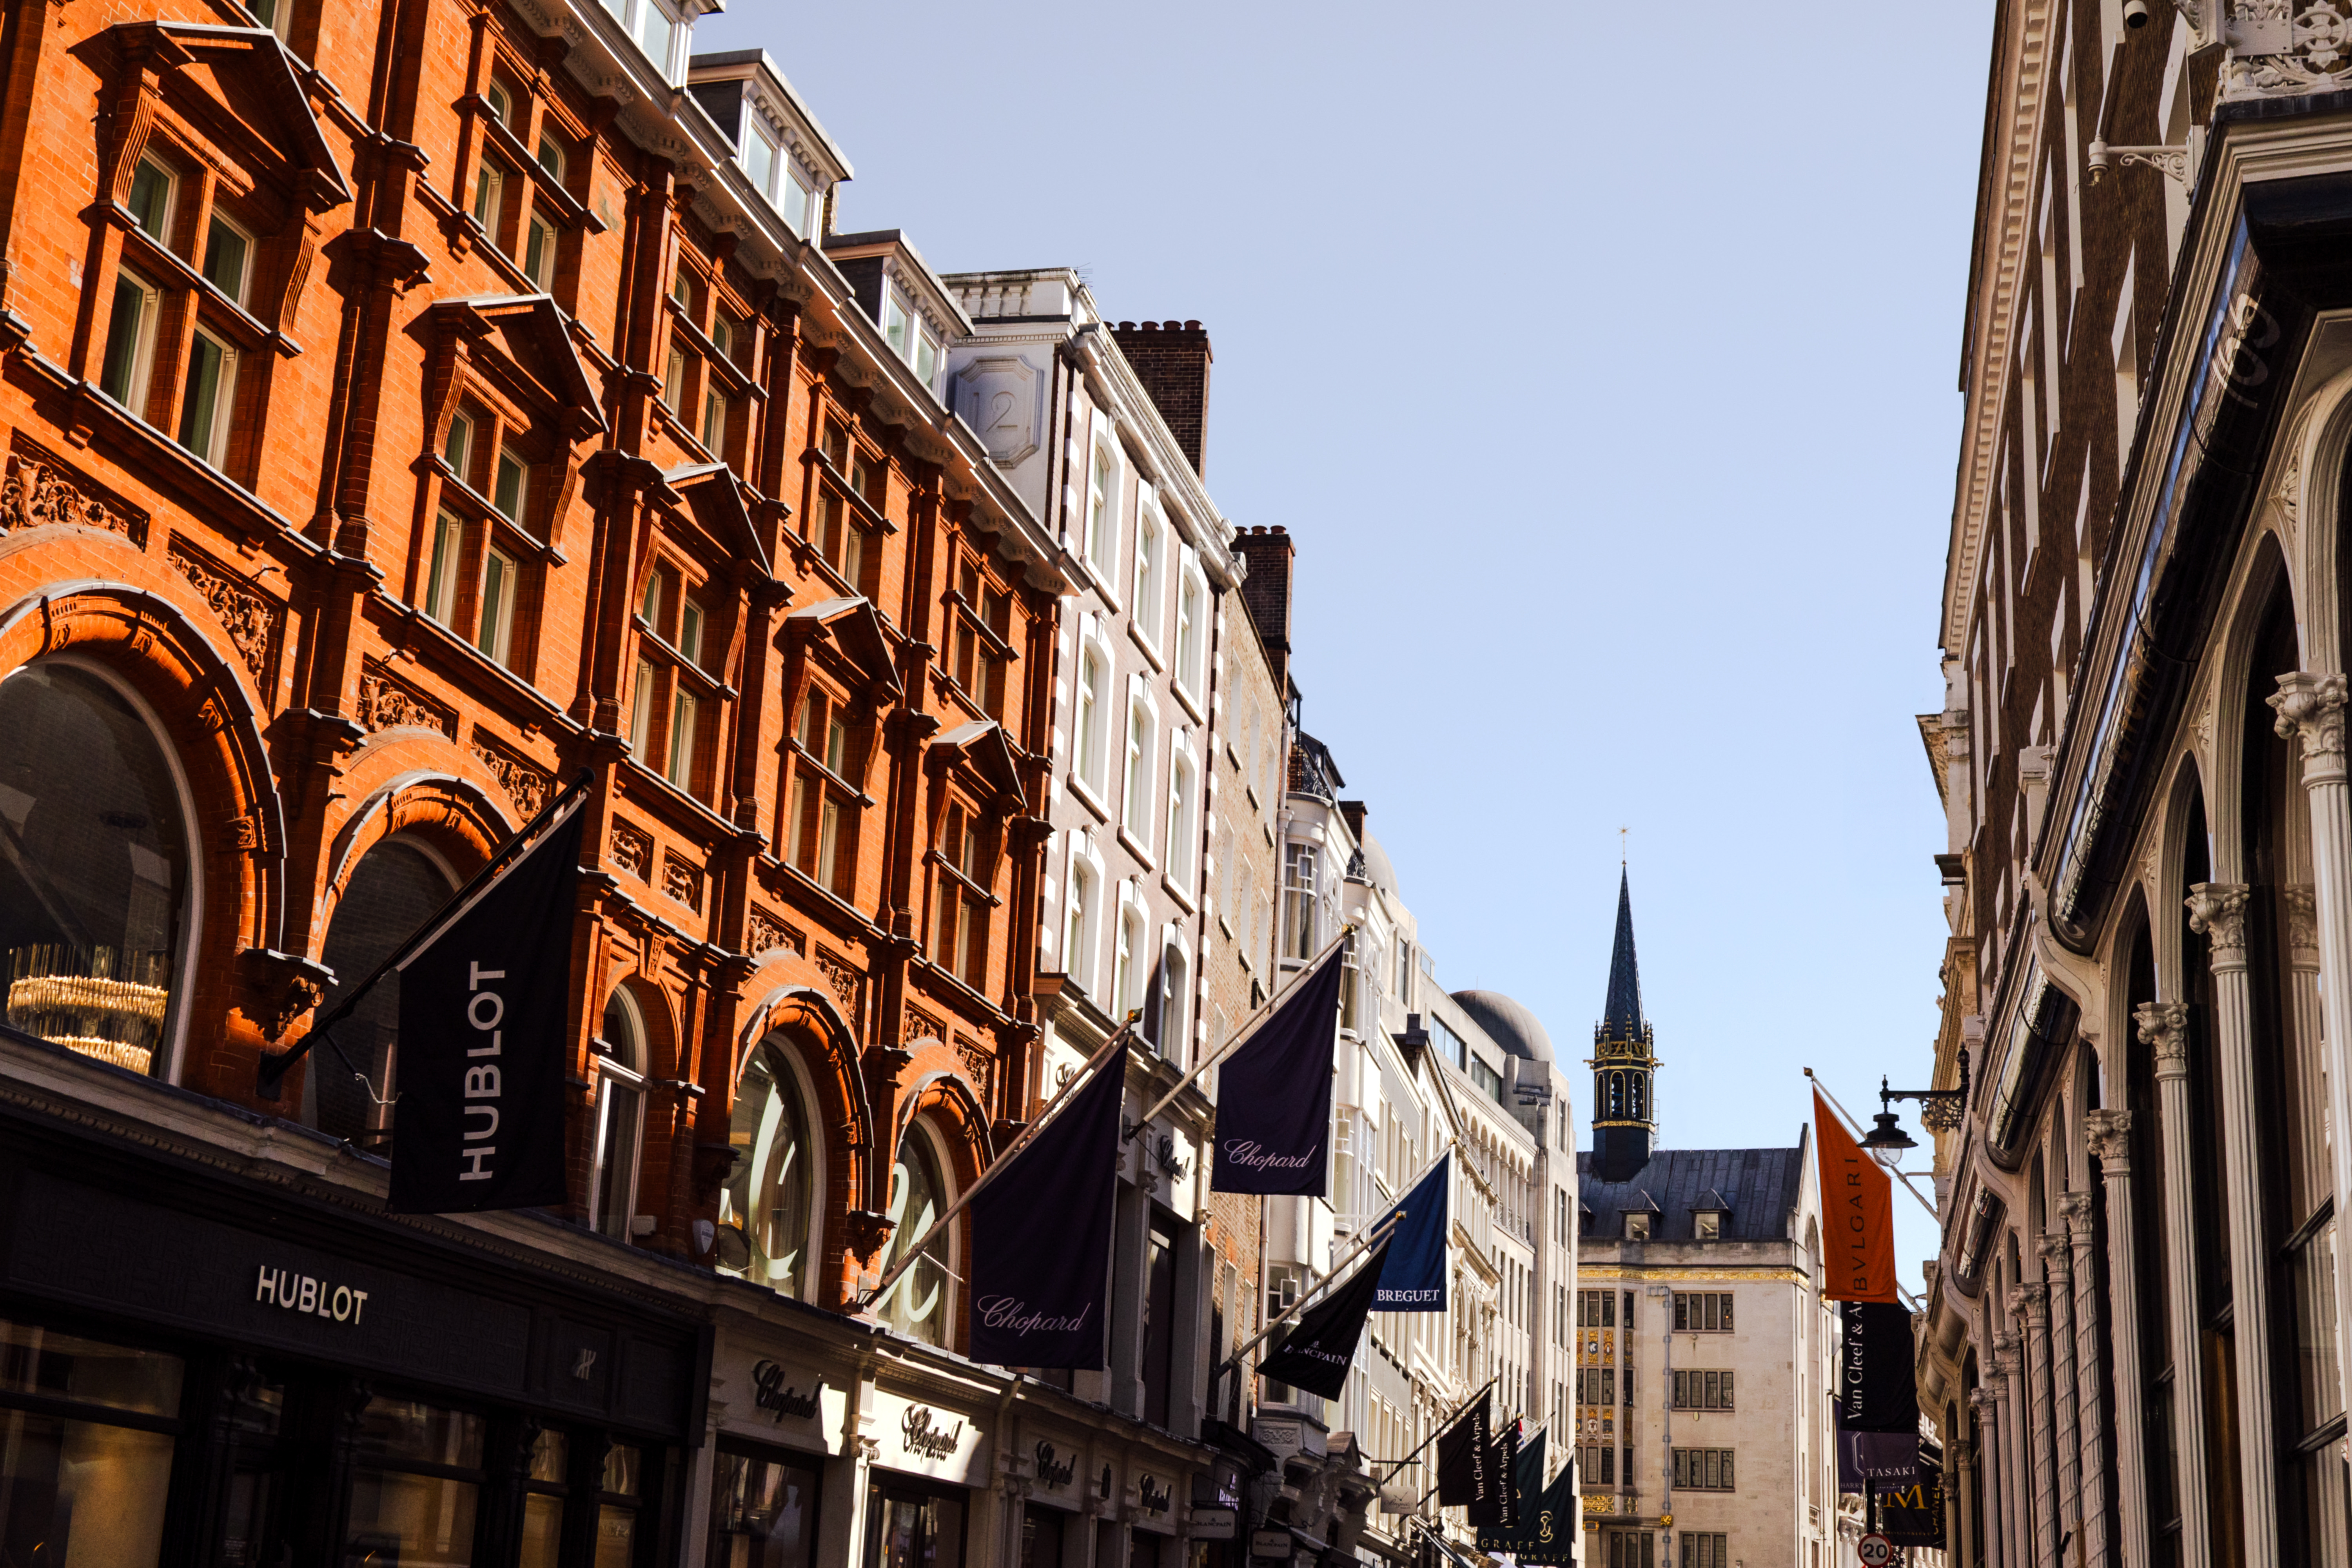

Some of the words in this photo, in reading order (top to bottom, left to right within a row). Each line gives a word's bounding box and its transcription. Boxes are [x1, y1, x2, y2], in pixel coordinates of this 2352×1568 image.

[459, 961, 505, 1181] HUBLOT
[1224, 1138, 1317, 1172] Chopard
[1845, 1158, 1867, 1291] BVLGARI
[256, 1265, 368, 1325] HUBLOT
[1377, 1289, 1440, 1302] BREGUET
[977, 1295, 1091, 1336] Chopard
[1851, 1323, 1863, 1335] &
[1283, 1343, 1348, 1366] BANCPAIN
[1847, 1338, 1863, 1384] Cleef
[752, 1360, 825, 1423] Chopard
[1847, 1390, 1863, 1419] Van
[902, 1403, 964, 1463] Chopard
[1472, 1412, 1483, 1442] Arpels
[1473, 1454, 1483, 1480] Cleef
[1499, 1443, 1509, 1469] Arpels
[1867, 1466, 1915, 1477] TASAKI
[1475, 1483, 1484, 1501] Van
[1499, 1480, 1508, 1505] Cleef
[1883, 1483, 1928, 1509] M
[1481, 1538, 1534, 1551] GRAFF
[1863, 1543, 1888, 1558] 20
